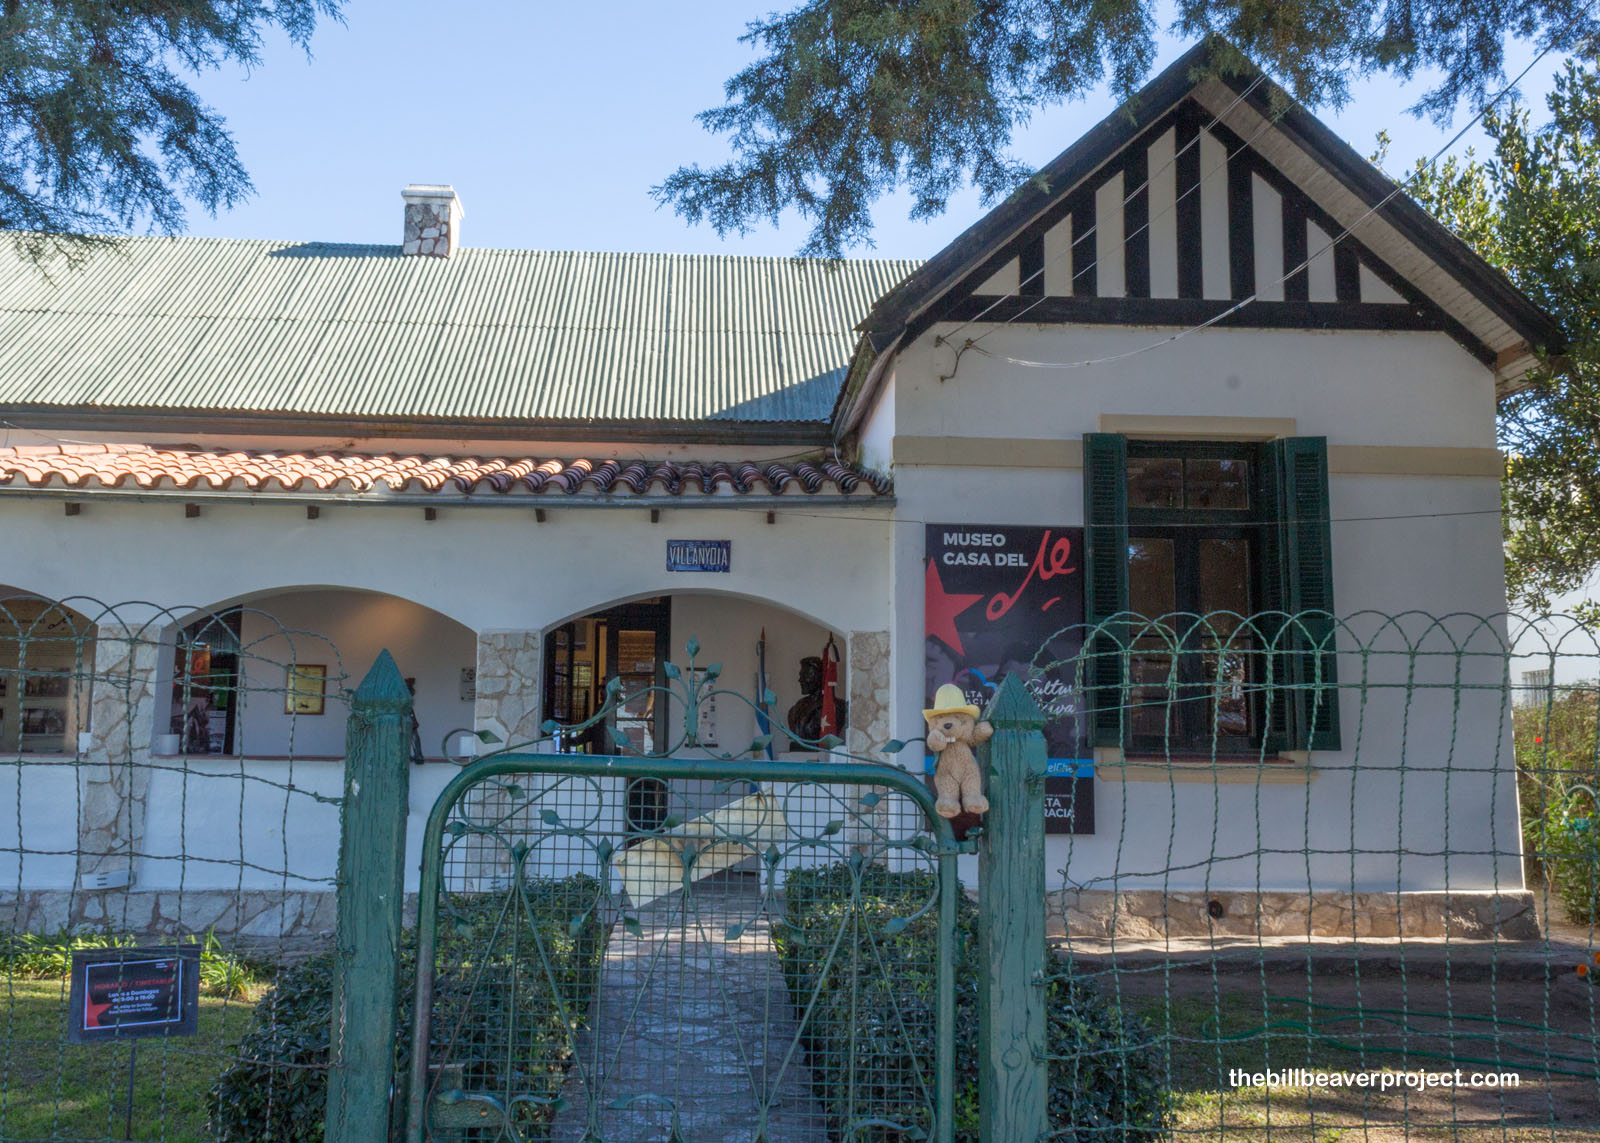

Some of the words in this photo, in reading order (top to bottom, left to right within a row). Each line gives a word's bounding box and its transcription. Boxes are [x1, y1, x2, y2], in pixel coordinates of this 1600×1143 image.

[943, 532, 1006, 547] MUSEO
[943, 552, 991, 567] CASA
[994, 553, 1029, 567] DEL
[965, 690, 983, 698] LTA
[1024, 678, 1076, 695] Cultur
[94, 981, 128, 990] HORARO
